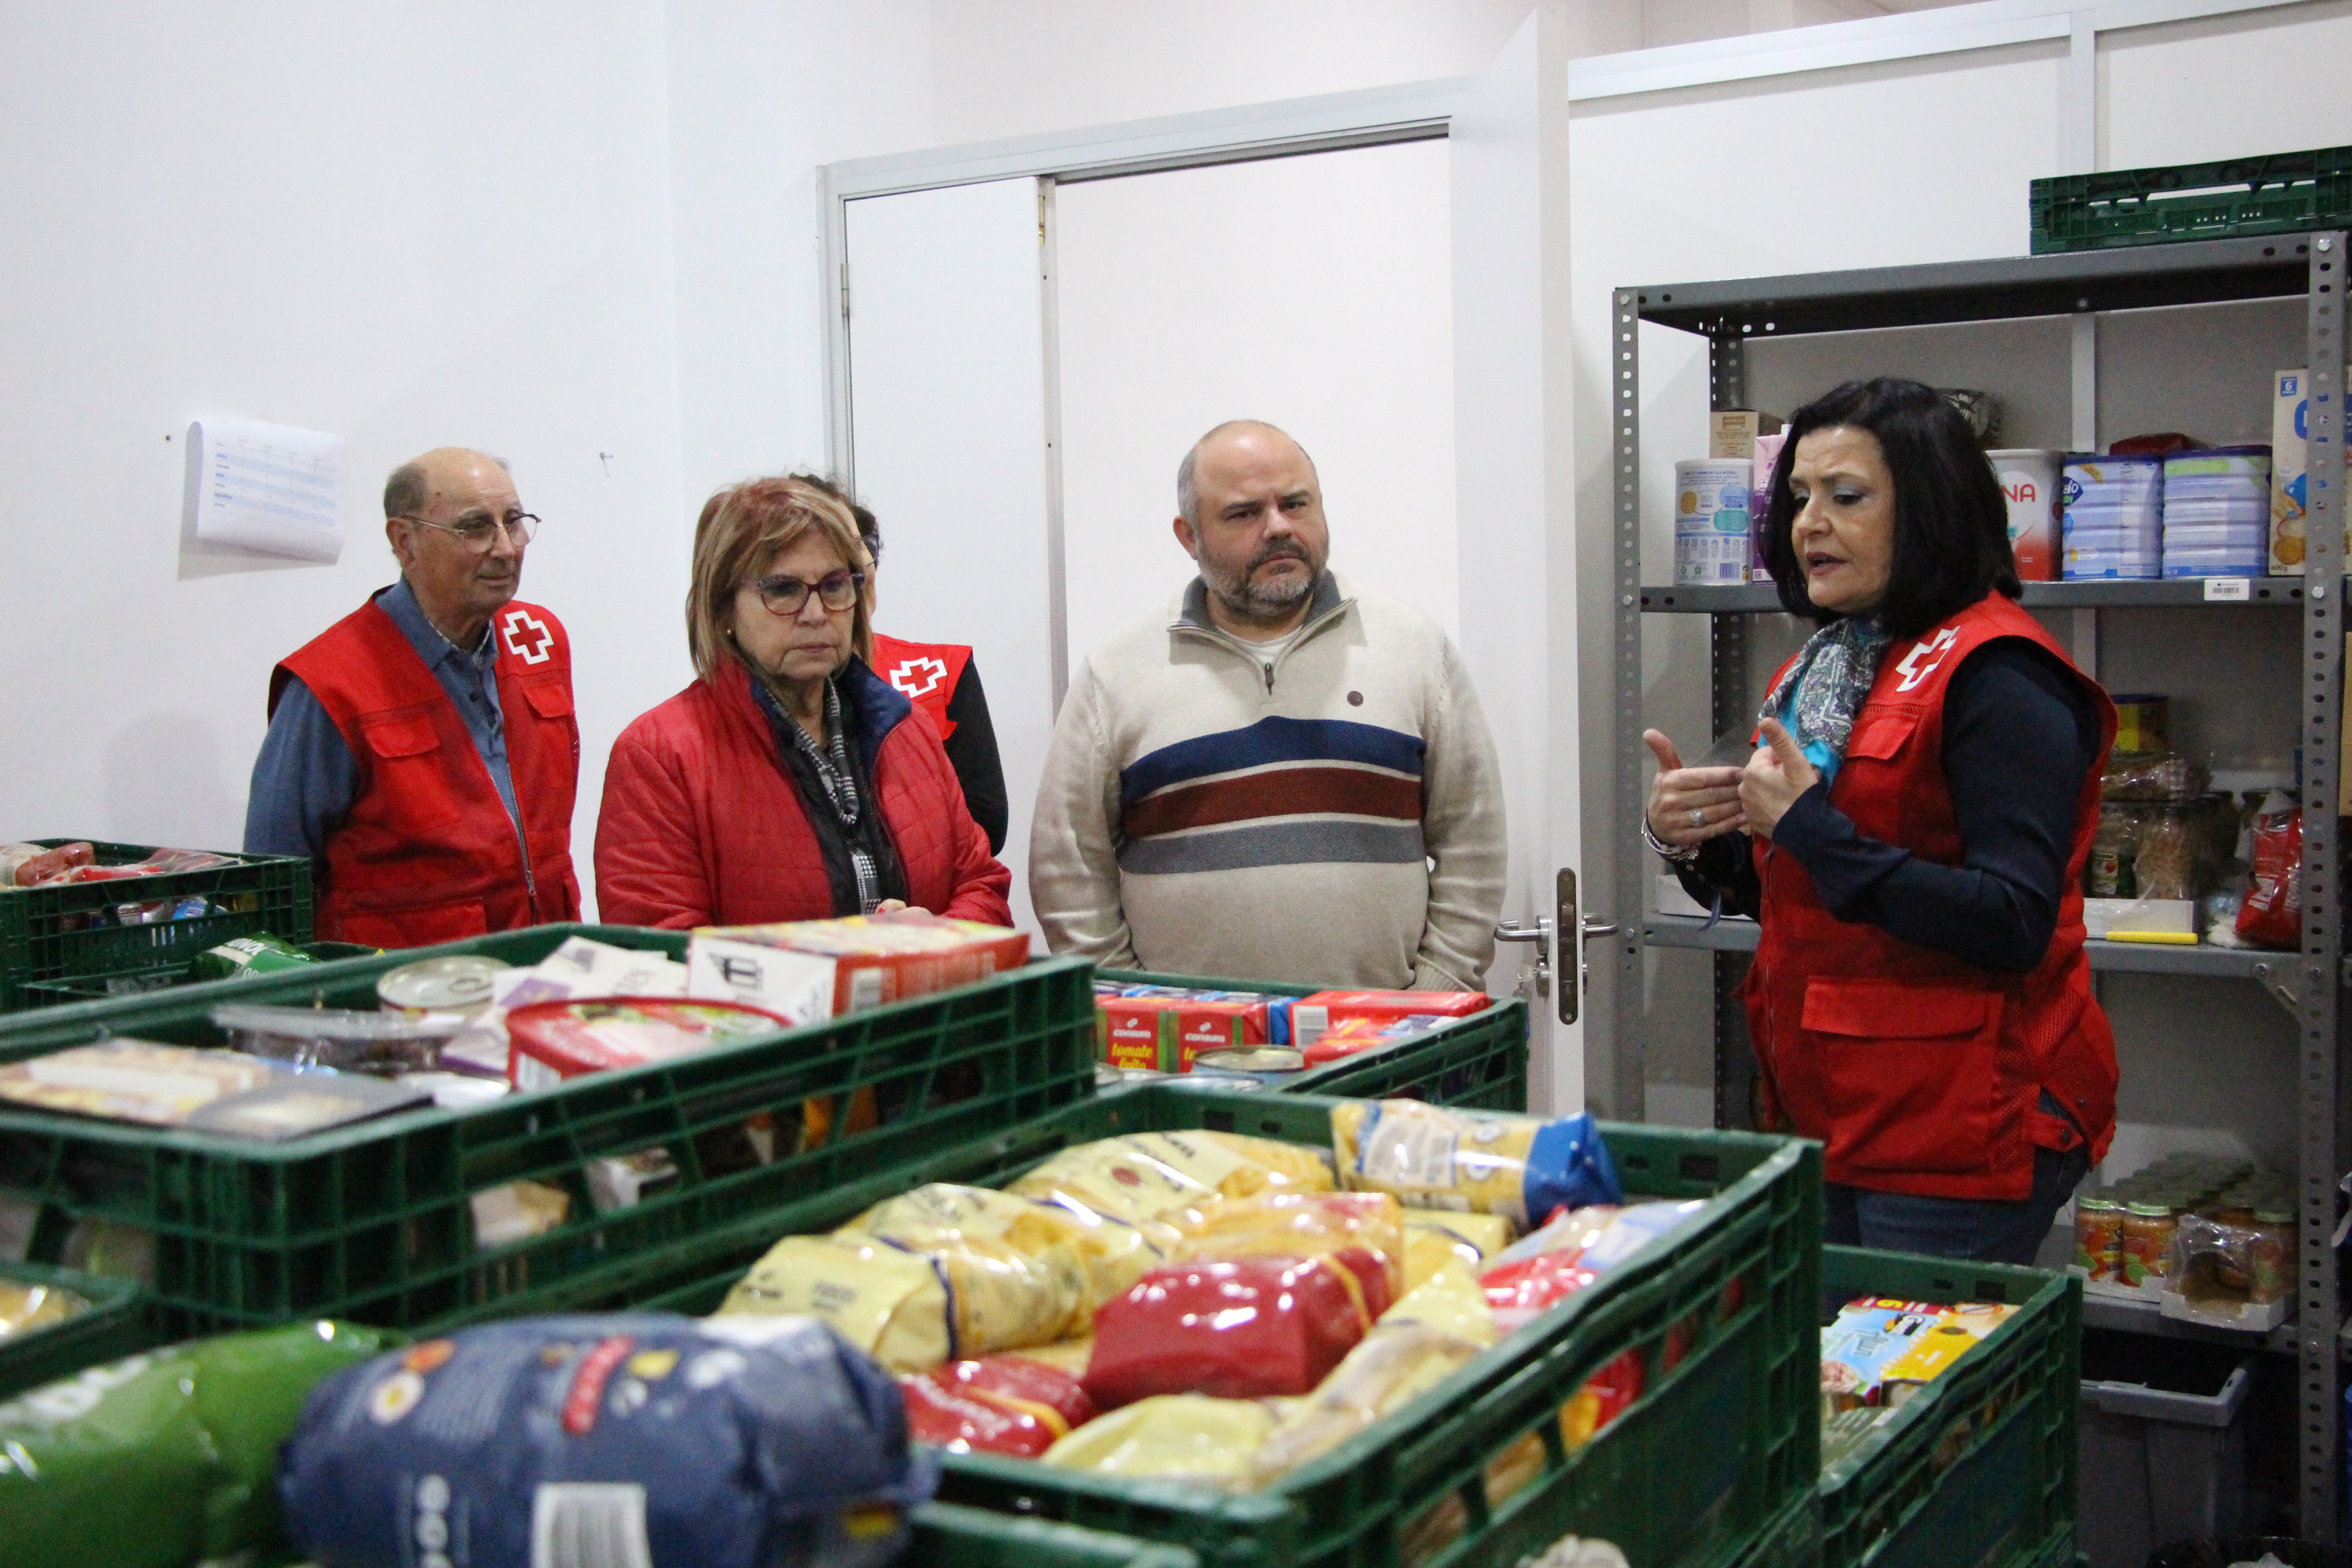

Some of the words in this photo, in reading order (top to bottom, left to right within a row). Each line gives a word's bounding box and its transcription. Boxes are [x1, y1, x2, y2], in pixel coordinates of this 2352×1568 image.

[1113, 1028, 1152, 1039] consum
[1185, 1032, 1226, 1043] consum
[1111, 1043, 1154, 1059] tomate
